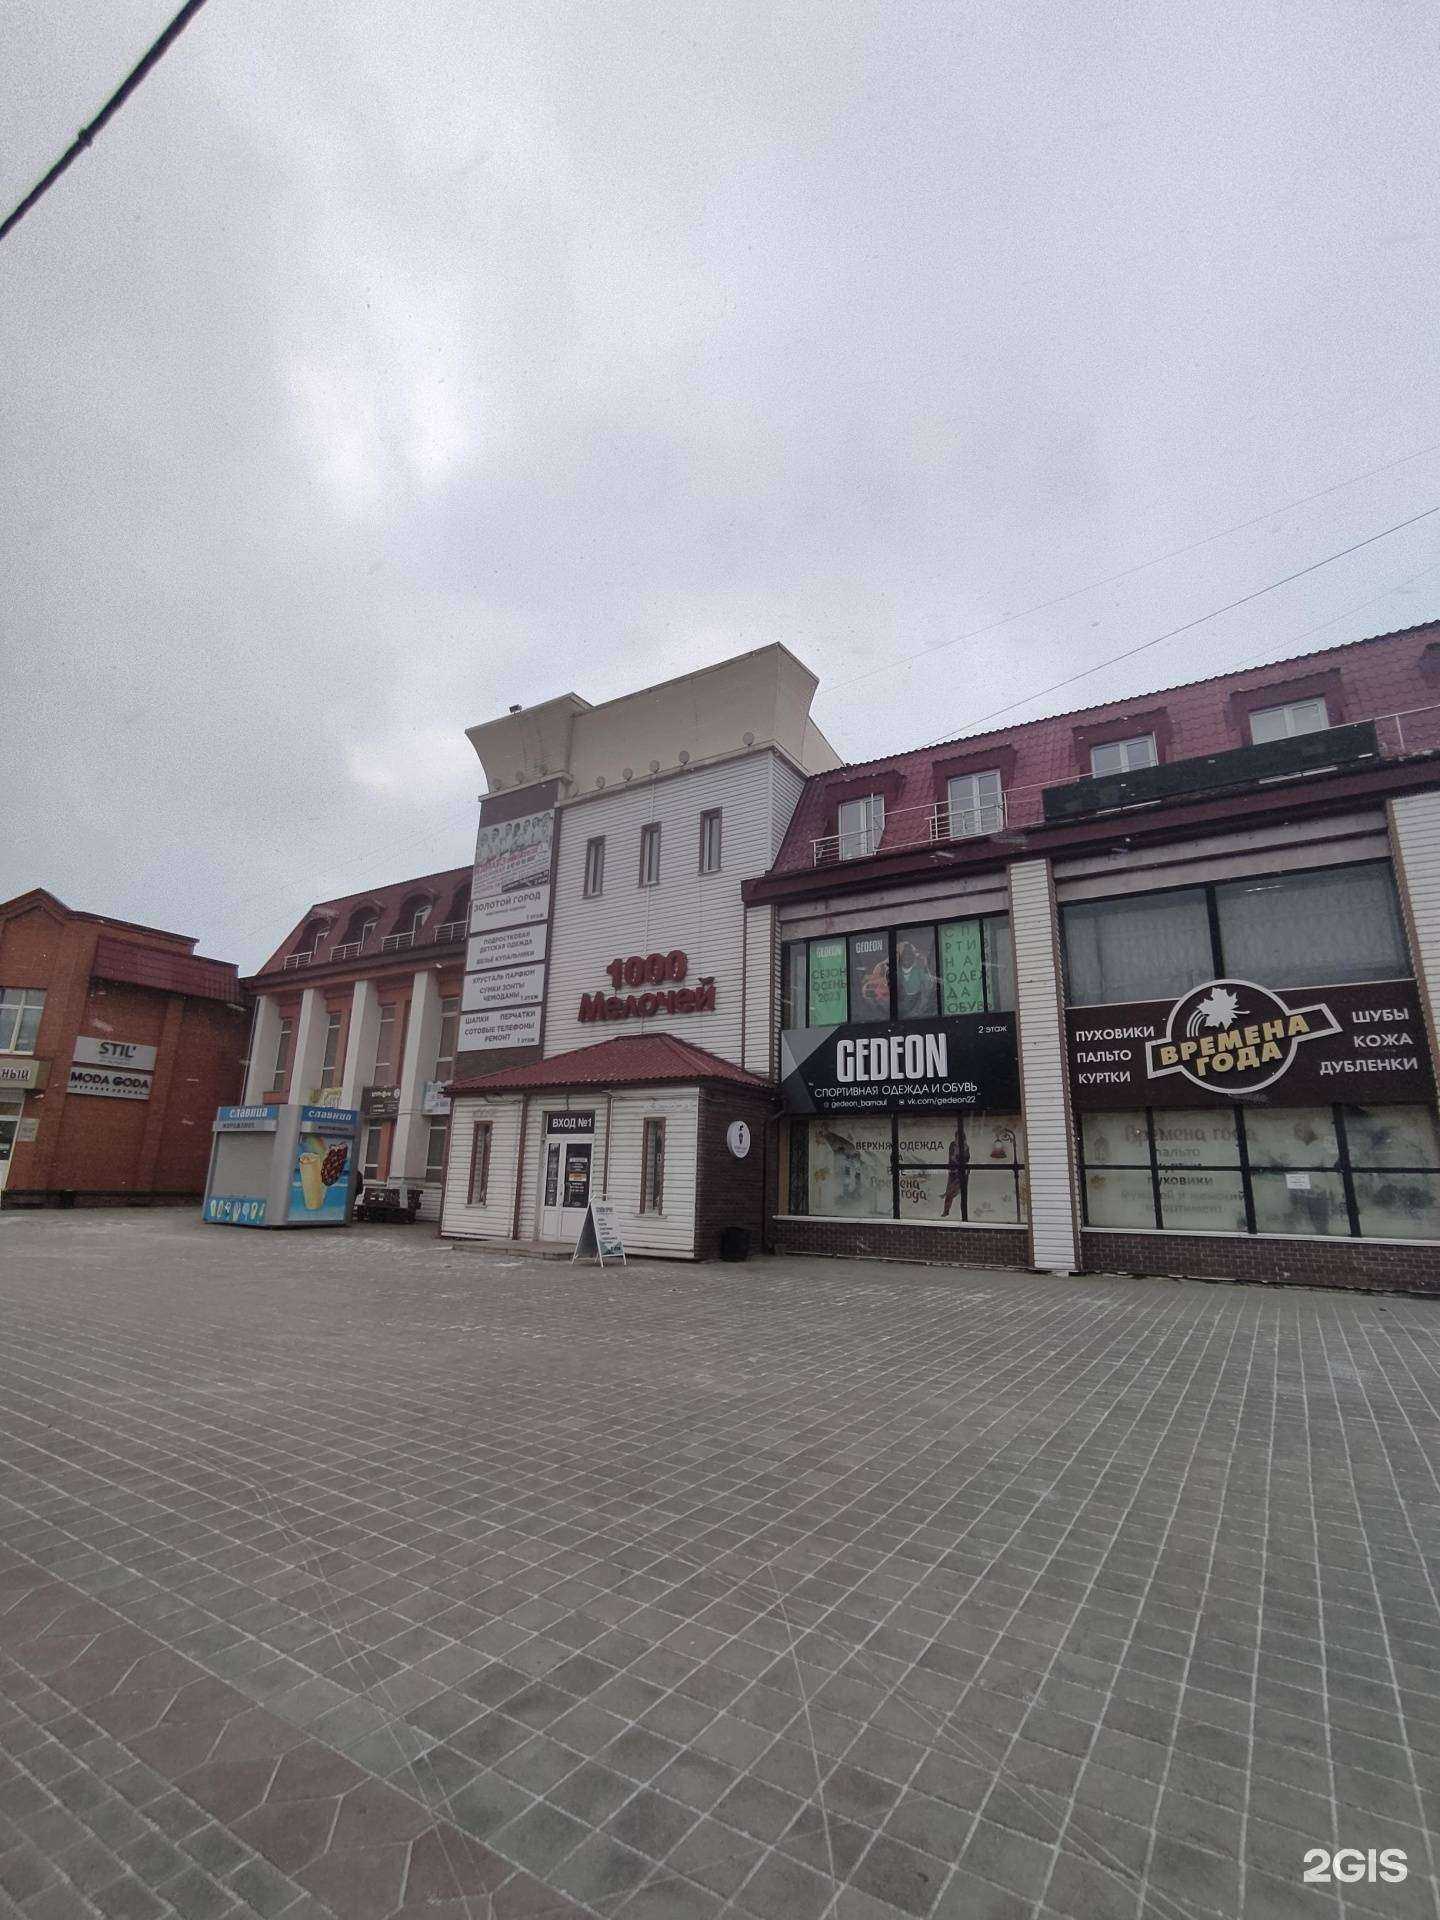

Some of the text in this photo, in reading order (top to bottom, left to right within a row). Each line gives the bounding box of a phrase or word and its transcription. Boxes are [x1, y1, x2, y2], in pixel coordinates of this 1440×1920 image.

[474, 896, 511, 912] ЗОЛОТОЙ
[513, 892, 541, 904] ГОРОД
[606, 950, 688, 991] 1000
[480, 986, 501, 994] СУМКИ
[483, 992, 520, 1001] ЧЕМОДАНЫ
[465, 1011, 536, 1025] ШАПКИ ПЕРЧАТКИ
[1352, 1008, 1411, 1024] ШУБЫ
[465, 1022, 535, 1035] СОТОВЫЕ ТЕЛЕФОНЫ
[977, 1025, 984, 1034] 2
[1075, 1026, 1155, 1042] ПУХОВИКИ
[485, 1034, 511, 1042] РЕМОНТ
[1160, 1015, 1311, 1066] ВРЕМЕНА
[1353, 1033, 1414, 1048] КОЖА
[836, 1033, 949, 1083] GEDEON
[1077, 1049, 1132, 1064] ПАЛЬТО
[1197, 1041, 1283, 1077] ГОДА
[1319, 1057, 1419, 1076] ДУБЛЕНКИ
[70, 1072, 149, 1089] MODA GODA
[1078, 1071, 1132, 1084] КУРТКИ
[814, 1082, 978, 1098] СПОРТИВНАЯ ОДЕЖДА И ОБУВЬ
[552, 1117, 592, 1129] ВХОД №1
[899, 1140, 945, 1151] ОДЕЖДА
